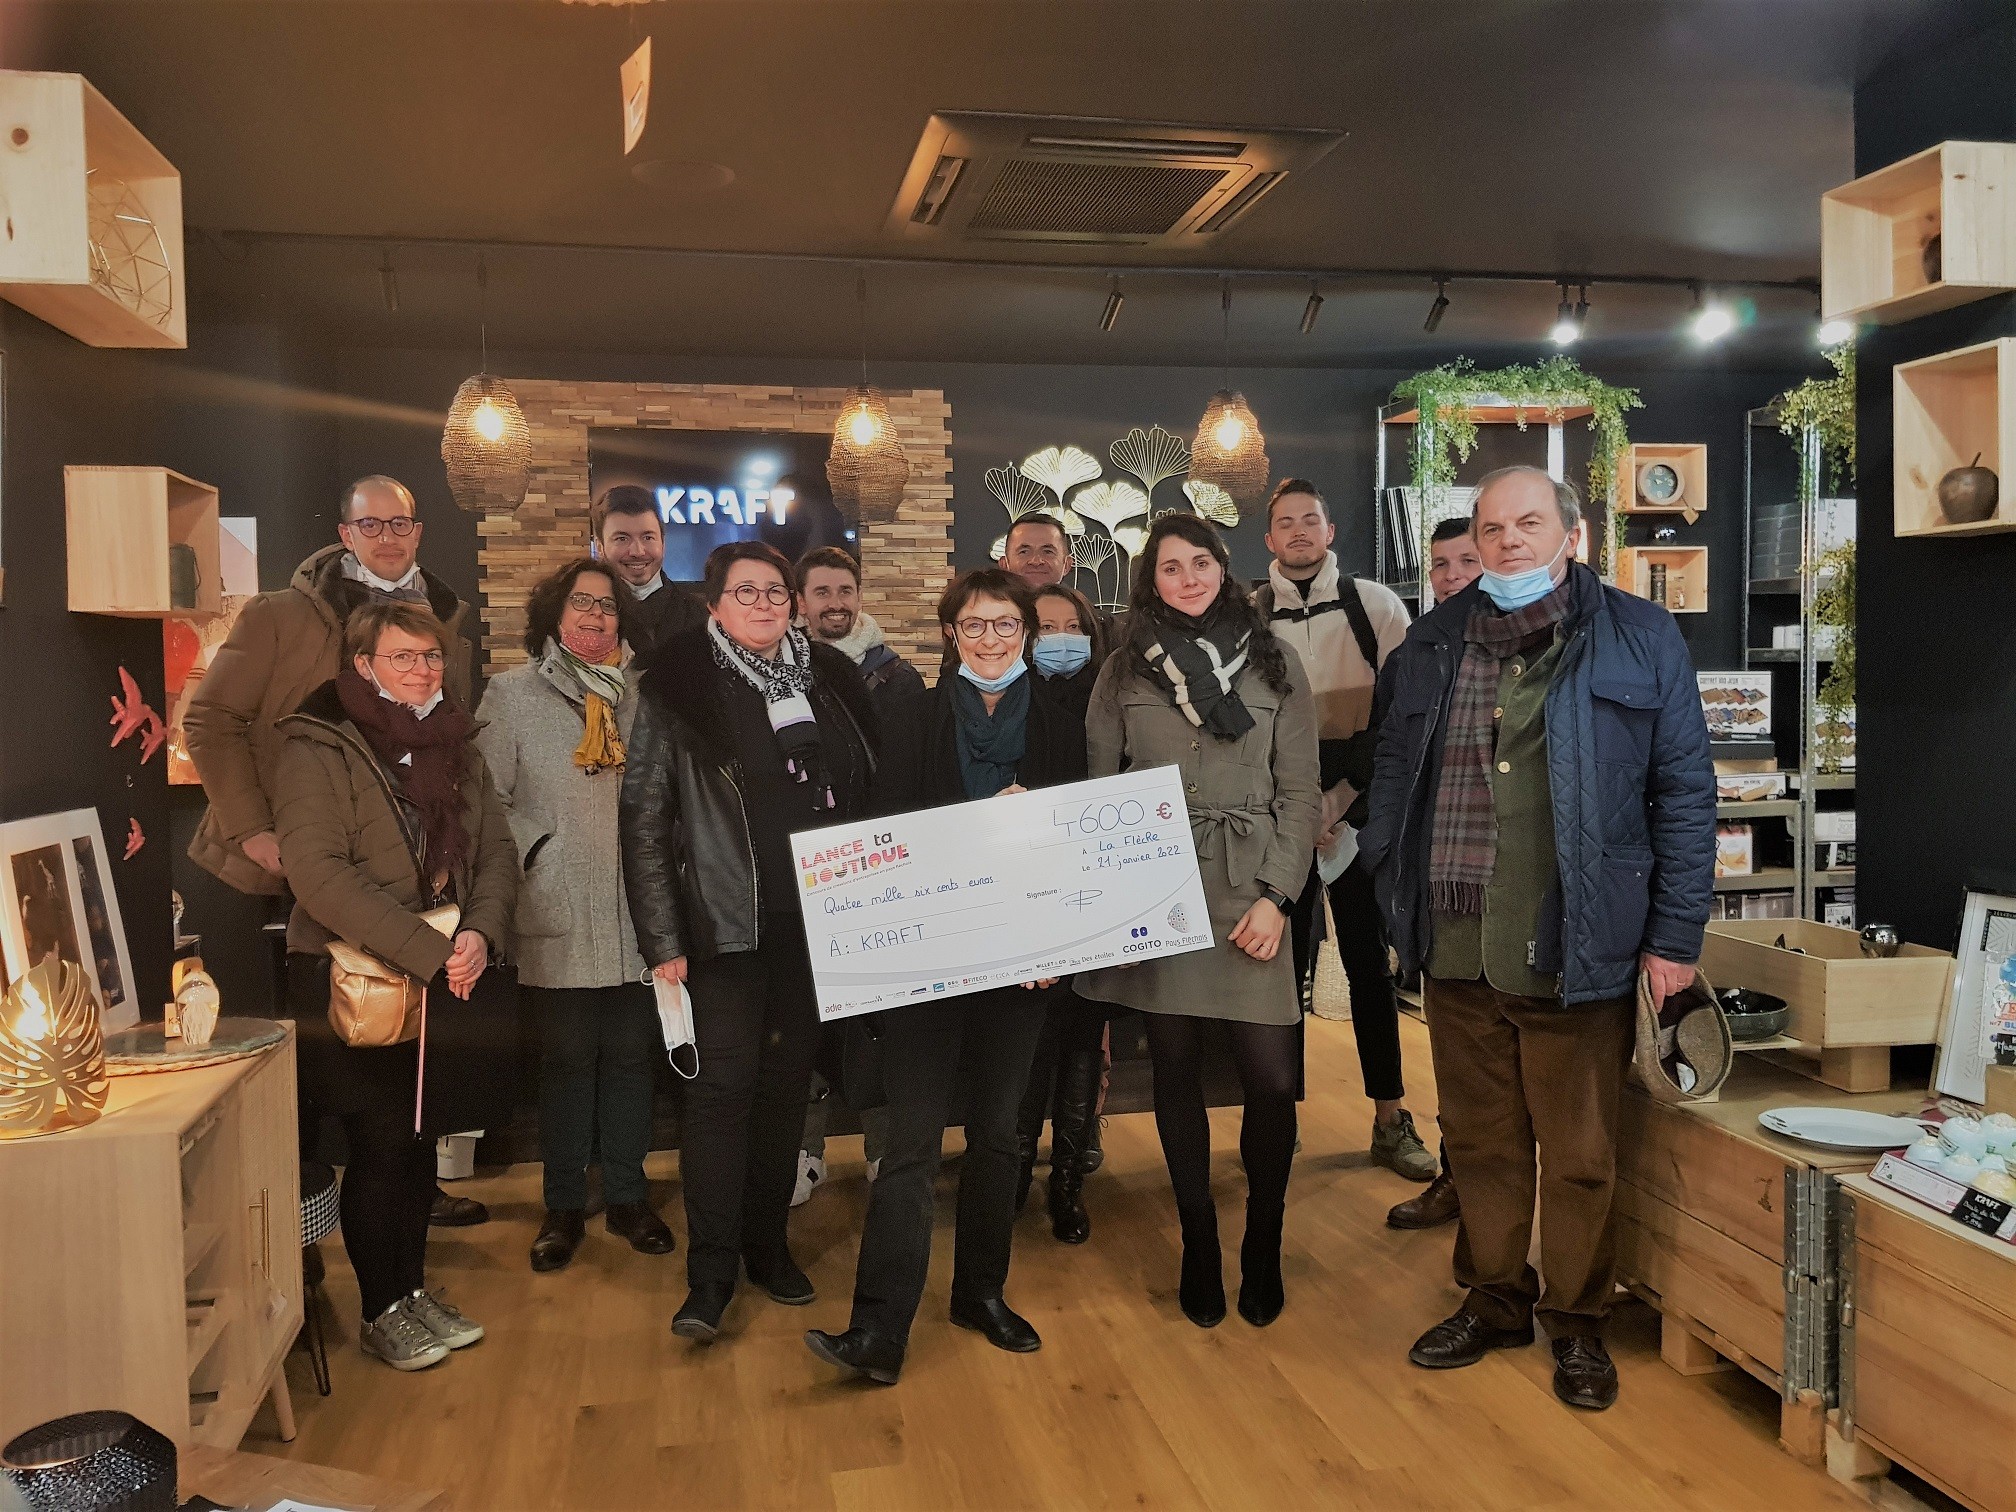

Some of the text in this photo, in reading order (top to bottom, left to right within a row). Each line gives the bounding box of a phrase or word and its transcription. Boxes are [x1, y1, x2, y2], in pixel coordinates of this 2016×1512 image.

[656, 487, 796, 526] KRAFT
[1053, 800, 1145, 837] 4600
[800, 832, 893, 870] LANCE ta
[1097, 855, 1111, 868] 21
[1116, 852, 1152, 871] janvier
[1157, 845, 1182, 859] 2022
[1099, 840, 1115, 852] La
[804, 842, 910, 889] BOUTIQUE
[871, 885, 905, 906] mille
[914, 886, 930, 897] six
[936, 878, 959, 893] cents
[968, 875, 994, 887] euros
[860, 923, 925, 952] KRAFT
[1122, 940, 1162, 954] COGITO
[1974, 1194, 2001, 1210] KRAFT
